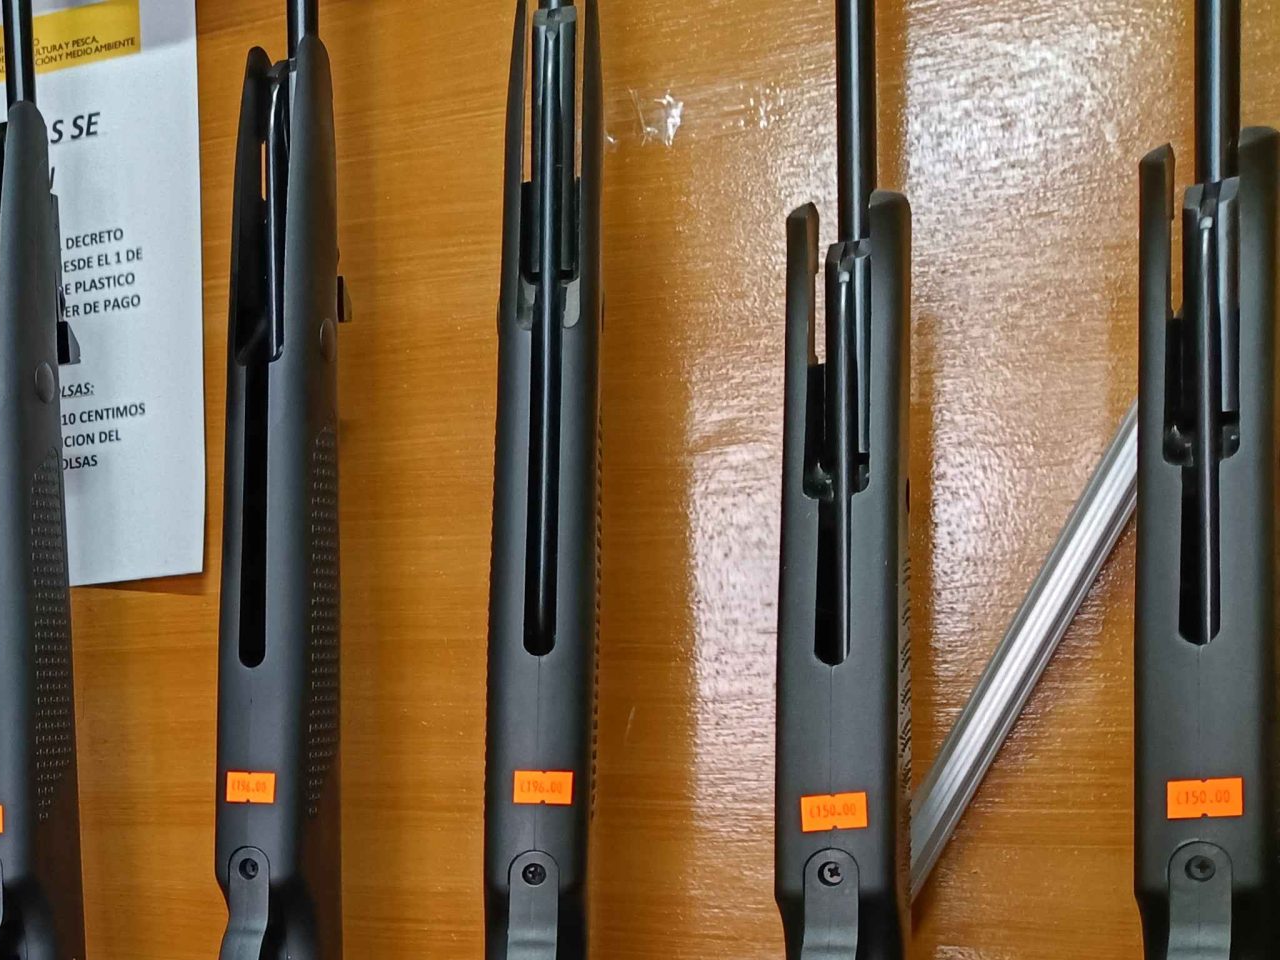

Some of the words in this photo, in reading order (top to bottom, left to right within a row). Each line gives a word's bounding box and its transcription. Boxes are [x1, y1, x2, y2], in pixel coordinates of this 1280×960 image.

[35, 42, 64, 57] LTURA
[64, 41, 70, 49] Y
[36, 54, 57, 66] CIÓN
[66, 47, 92, 60] MEDIO
[94, 37, 136, 54] AMBIENTE
[70, 111, 101, 140] SE
[66, 228, 124, 250] DECRETO
[62, 256, 93, 273] ESDE
[97, 253, 110, 267] EL
[115, 251, 122, 264] 1
[126, 247, 143, 263] DE
[75, 272, 135, 294] PLASTICO
[65, 304, 80, 318] ER
[83, 301, 100, 316] DE
[104, 294, 141, 312] PAGO
[61, 382, 95, 398] LSAS:
[79, 402, 145, 424] CENTIMOS
[64, 432, 95, 448] CION
[99, 429, 122, 443] DEL
